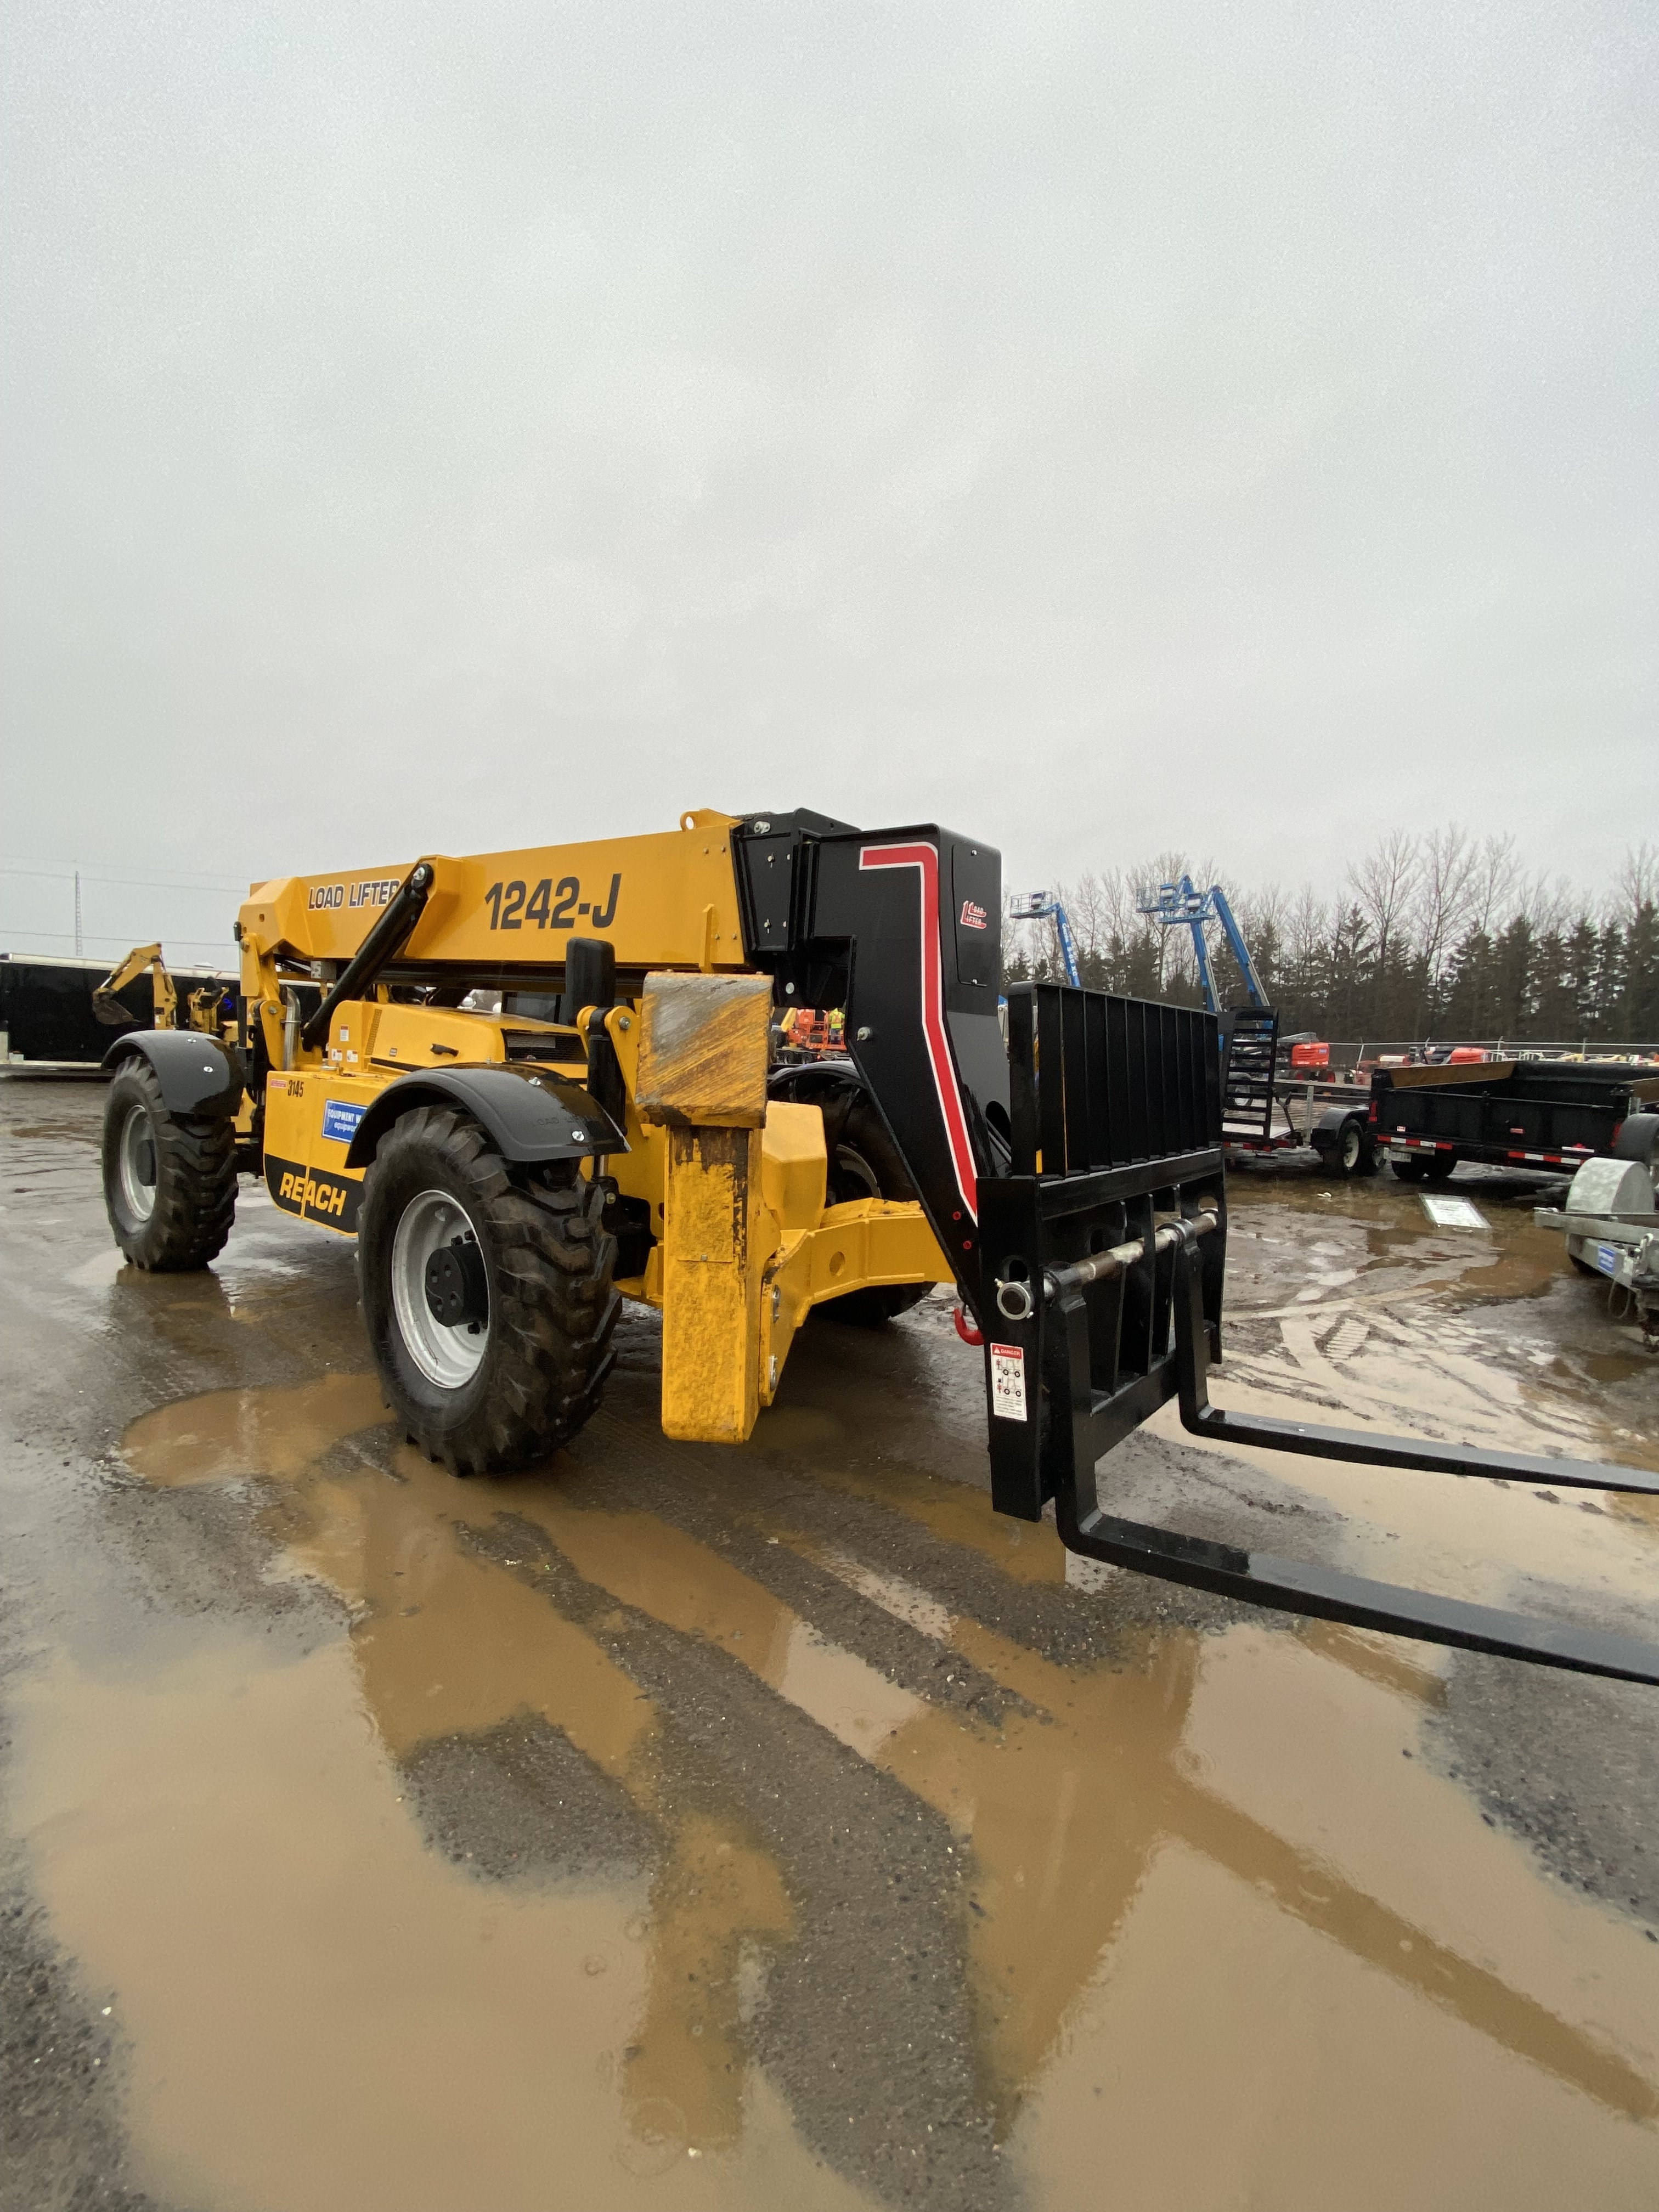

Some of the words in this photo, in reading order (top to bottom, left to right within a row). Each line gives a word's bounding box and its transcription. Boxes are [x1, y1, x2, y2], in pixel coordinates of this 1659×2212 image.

[308, 884, 345, 911] LOAD
[484, 873, 622, 930] 1242-J
[287, 1079, 304, 1098] 3145
[328, 1108, 354, 1122] EQUIPMENT
[279, 1172, 347, 1216] REACH
